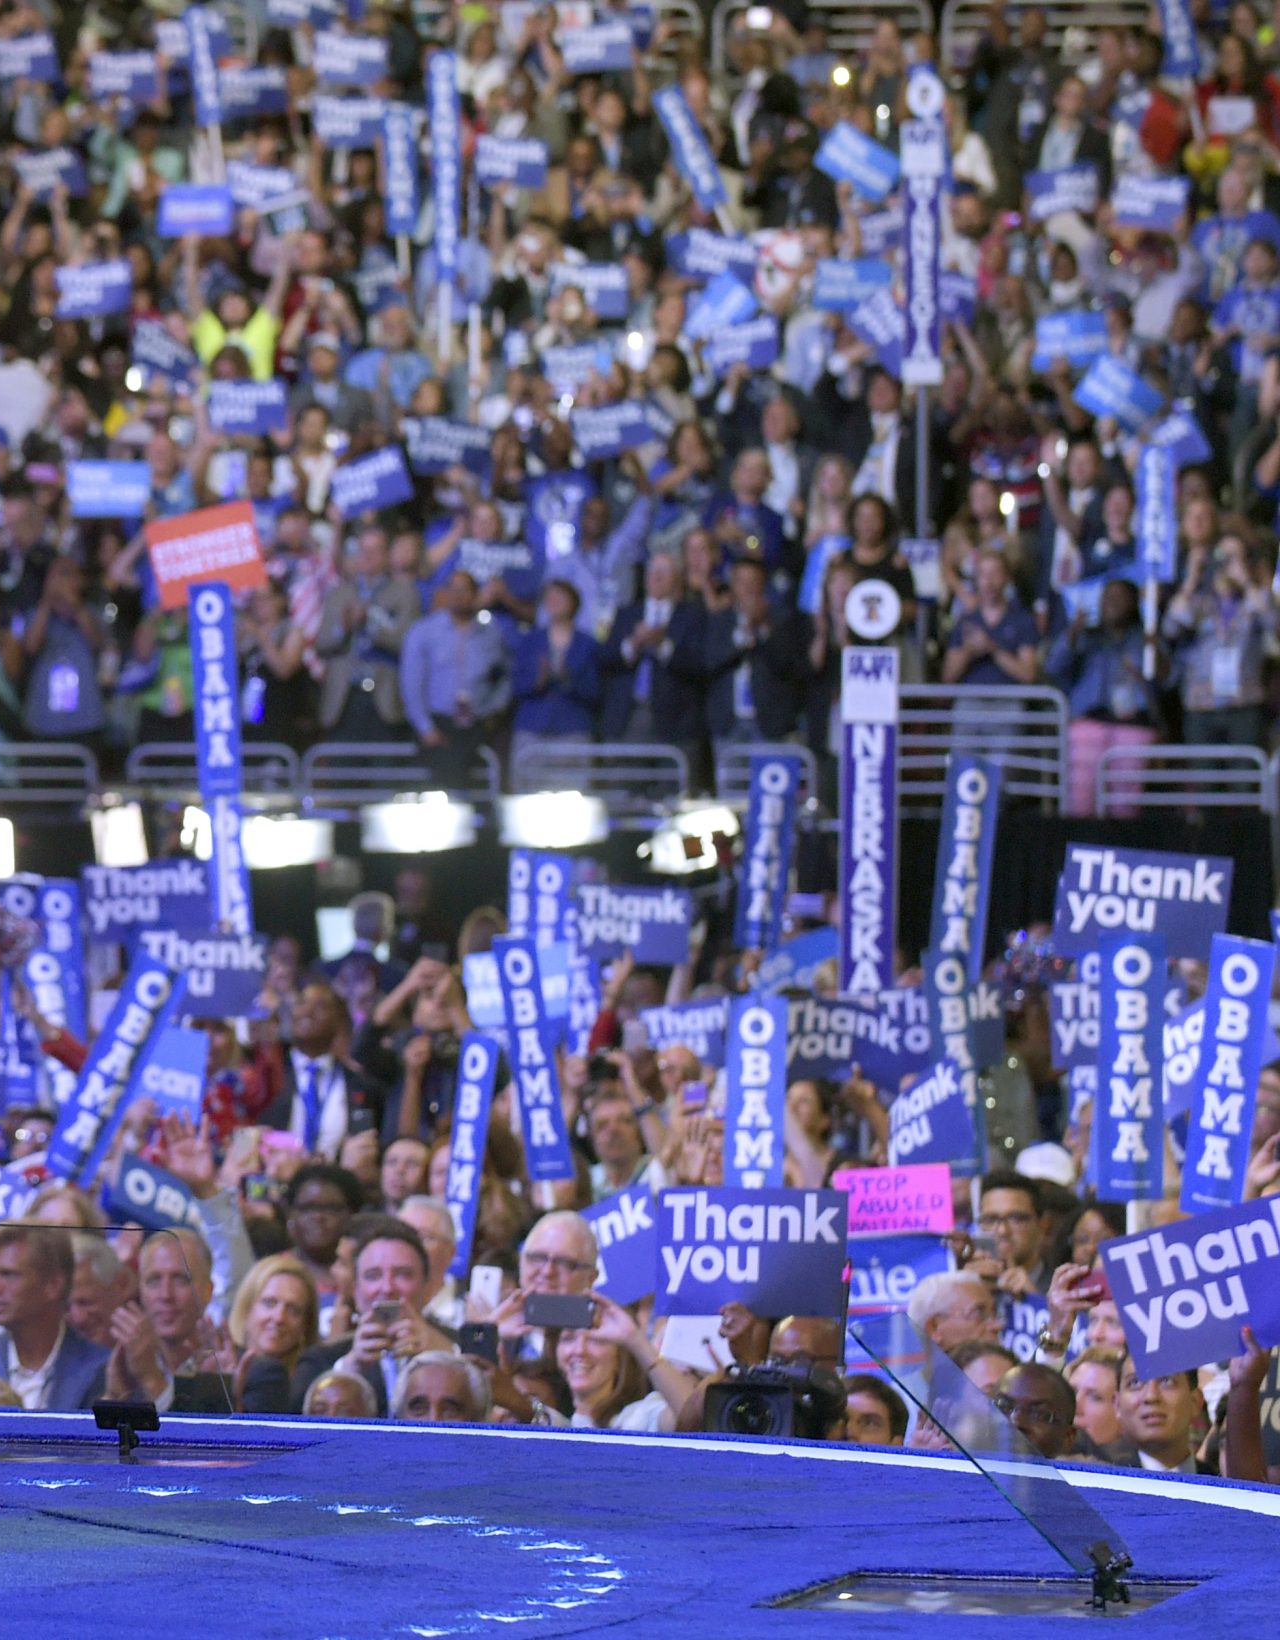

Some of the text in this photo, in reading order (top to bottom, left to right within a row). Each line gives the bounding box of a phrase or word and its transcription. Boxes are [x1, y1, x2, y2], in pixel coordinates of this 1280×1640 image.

[196, 590, 235, 768] OBAMA
[82, 859, 207, 897] Thank
[849, 724, 887, 996] NEBRASKA
[939, 767, 987, 952] OBAMA
[1070, 847, 1224, 904] Thank
[86, 895, 162, 932] you
[577, 884, 686, 926] Thank
[577, 914, 643, 949] you
[1066, 889, 1157, 933] you
[140, 929, 267, 972] Thank
[504, 946, 559, 1147] OBAMA
[785, 998, 900, 1055] Thank
[1108, 945, 1153, 1163] OBAMA
[61, 970, 172, 1149] OBAMA
[140, 1063, 203, 1099] can
[1195, 953, 1261, 1179] OBAMA
[448, 1042, 490, 1242] OBAMA
[847, 1173, 908, 1195] STOP
[857, 1193, 945, 1215] ABUSED
[664, 1192, 840, 1245] Thank
[661, 1244, 761, 1295] you
[1122, 1274, 1251, 1354] you
